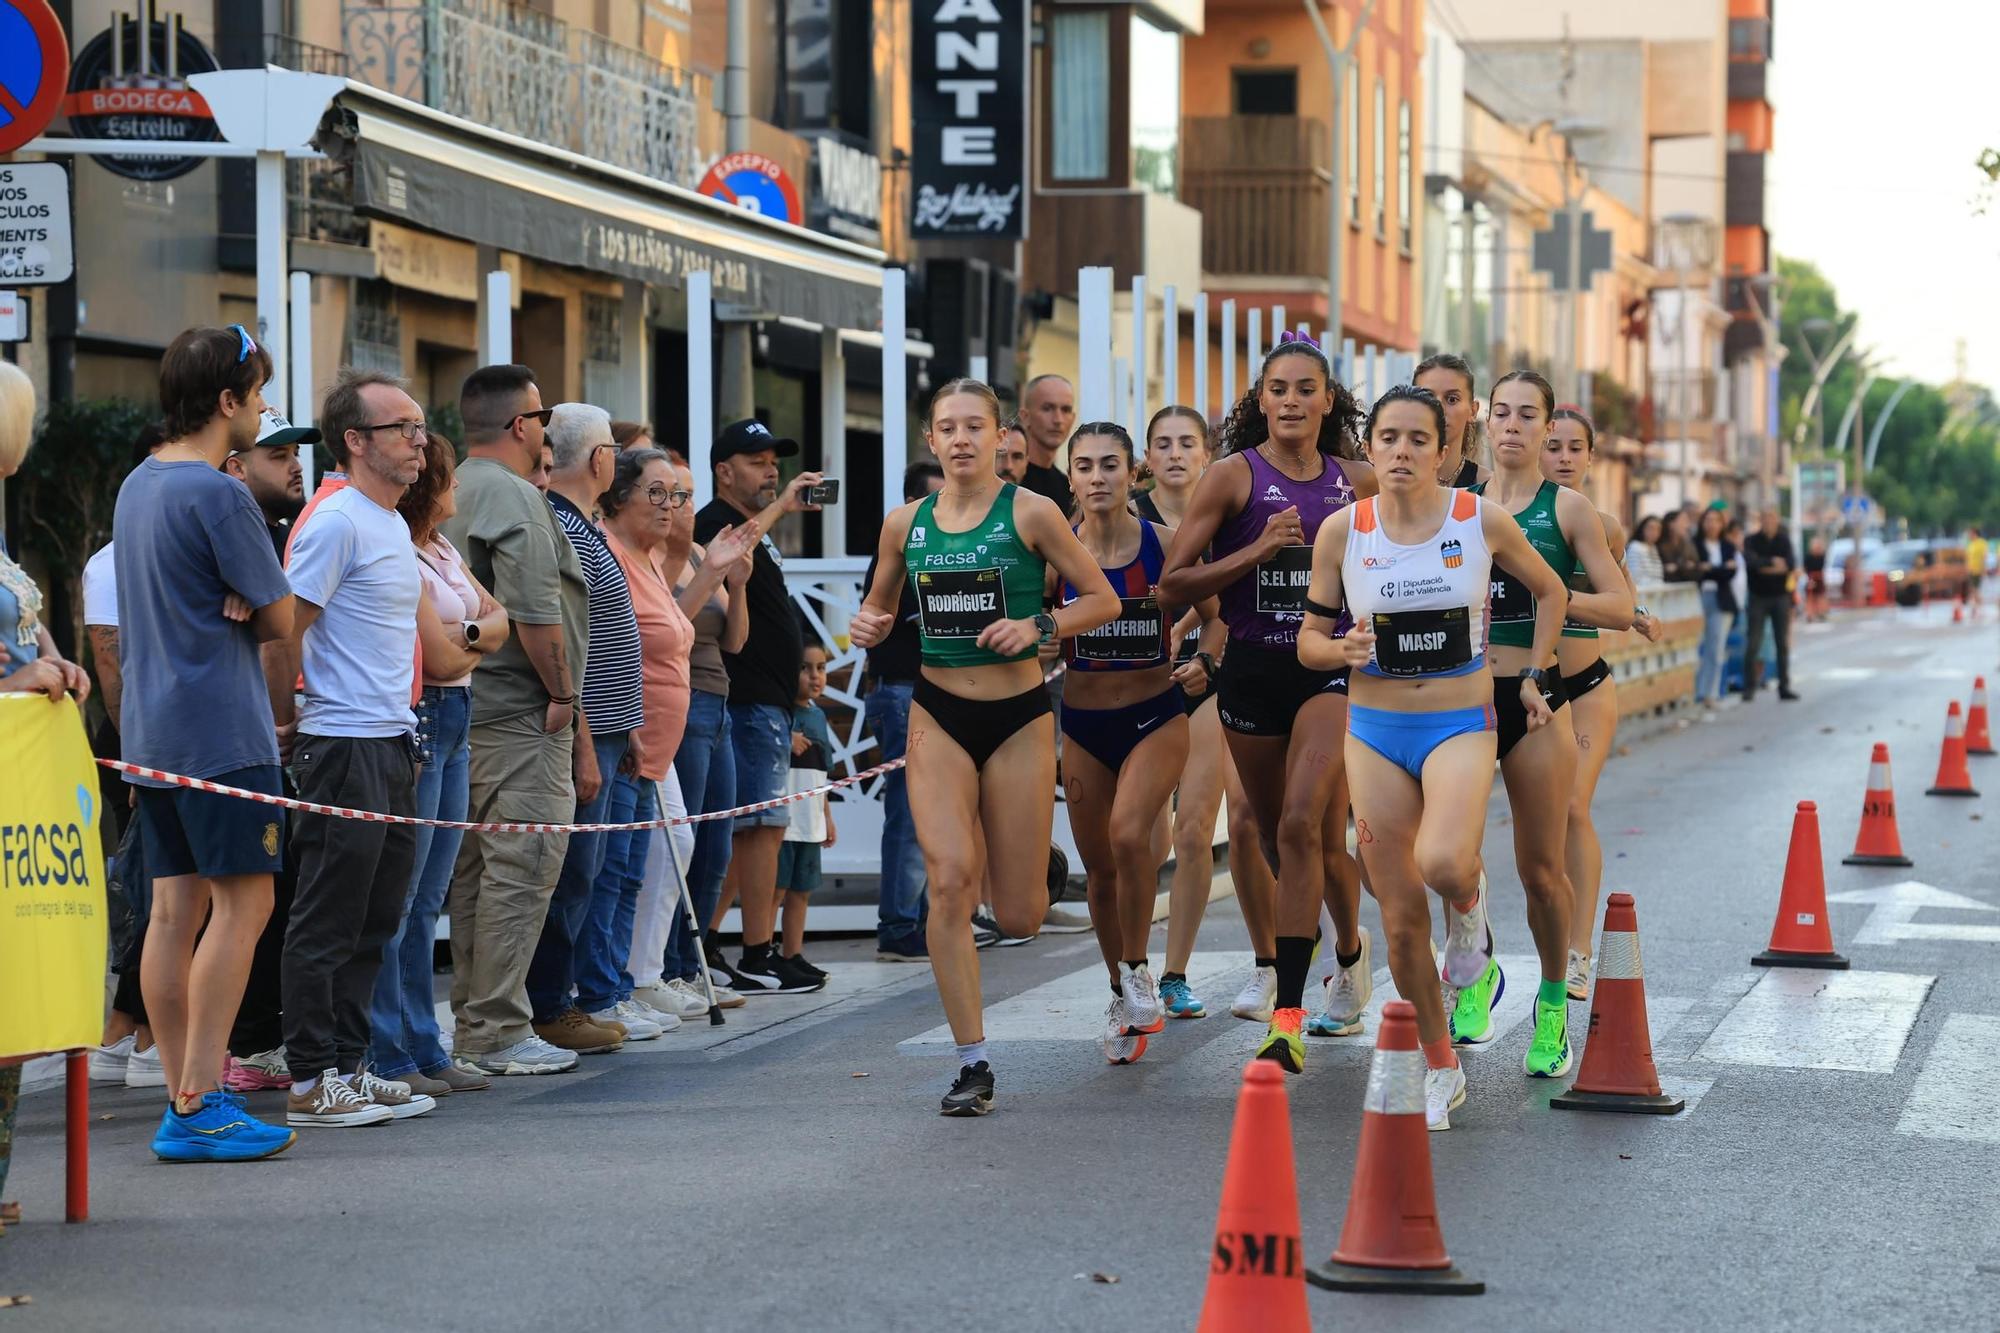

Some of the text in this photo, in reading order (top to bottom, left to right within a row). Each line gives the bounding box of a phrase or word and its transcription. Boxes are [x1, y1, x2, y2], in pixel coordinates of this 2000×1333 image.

[934, 0, 1001, 165] ANTE
[92, 92, 193, 112] BODEGA
[107, 117, 185, 137] Estrella
[0, 170, 13, 183] S
[713, 153, 781, 180] EXCEPTO
[599, 225, 626, 262] LOS
[627, 229, 673, 274] MAÑOS
[925, 552, 977, 566] Facsa
[1260, 571, 1286, 587] S.EL
[1403, 576, 1443, 588] Diputació
[926, 590, 997, 612] RODRÍGUEZ
[1403, 585, 1452, 597] de València
[1398, 631, 1447, 652] MASIP
[2, 823, 89, 888] Facsa
